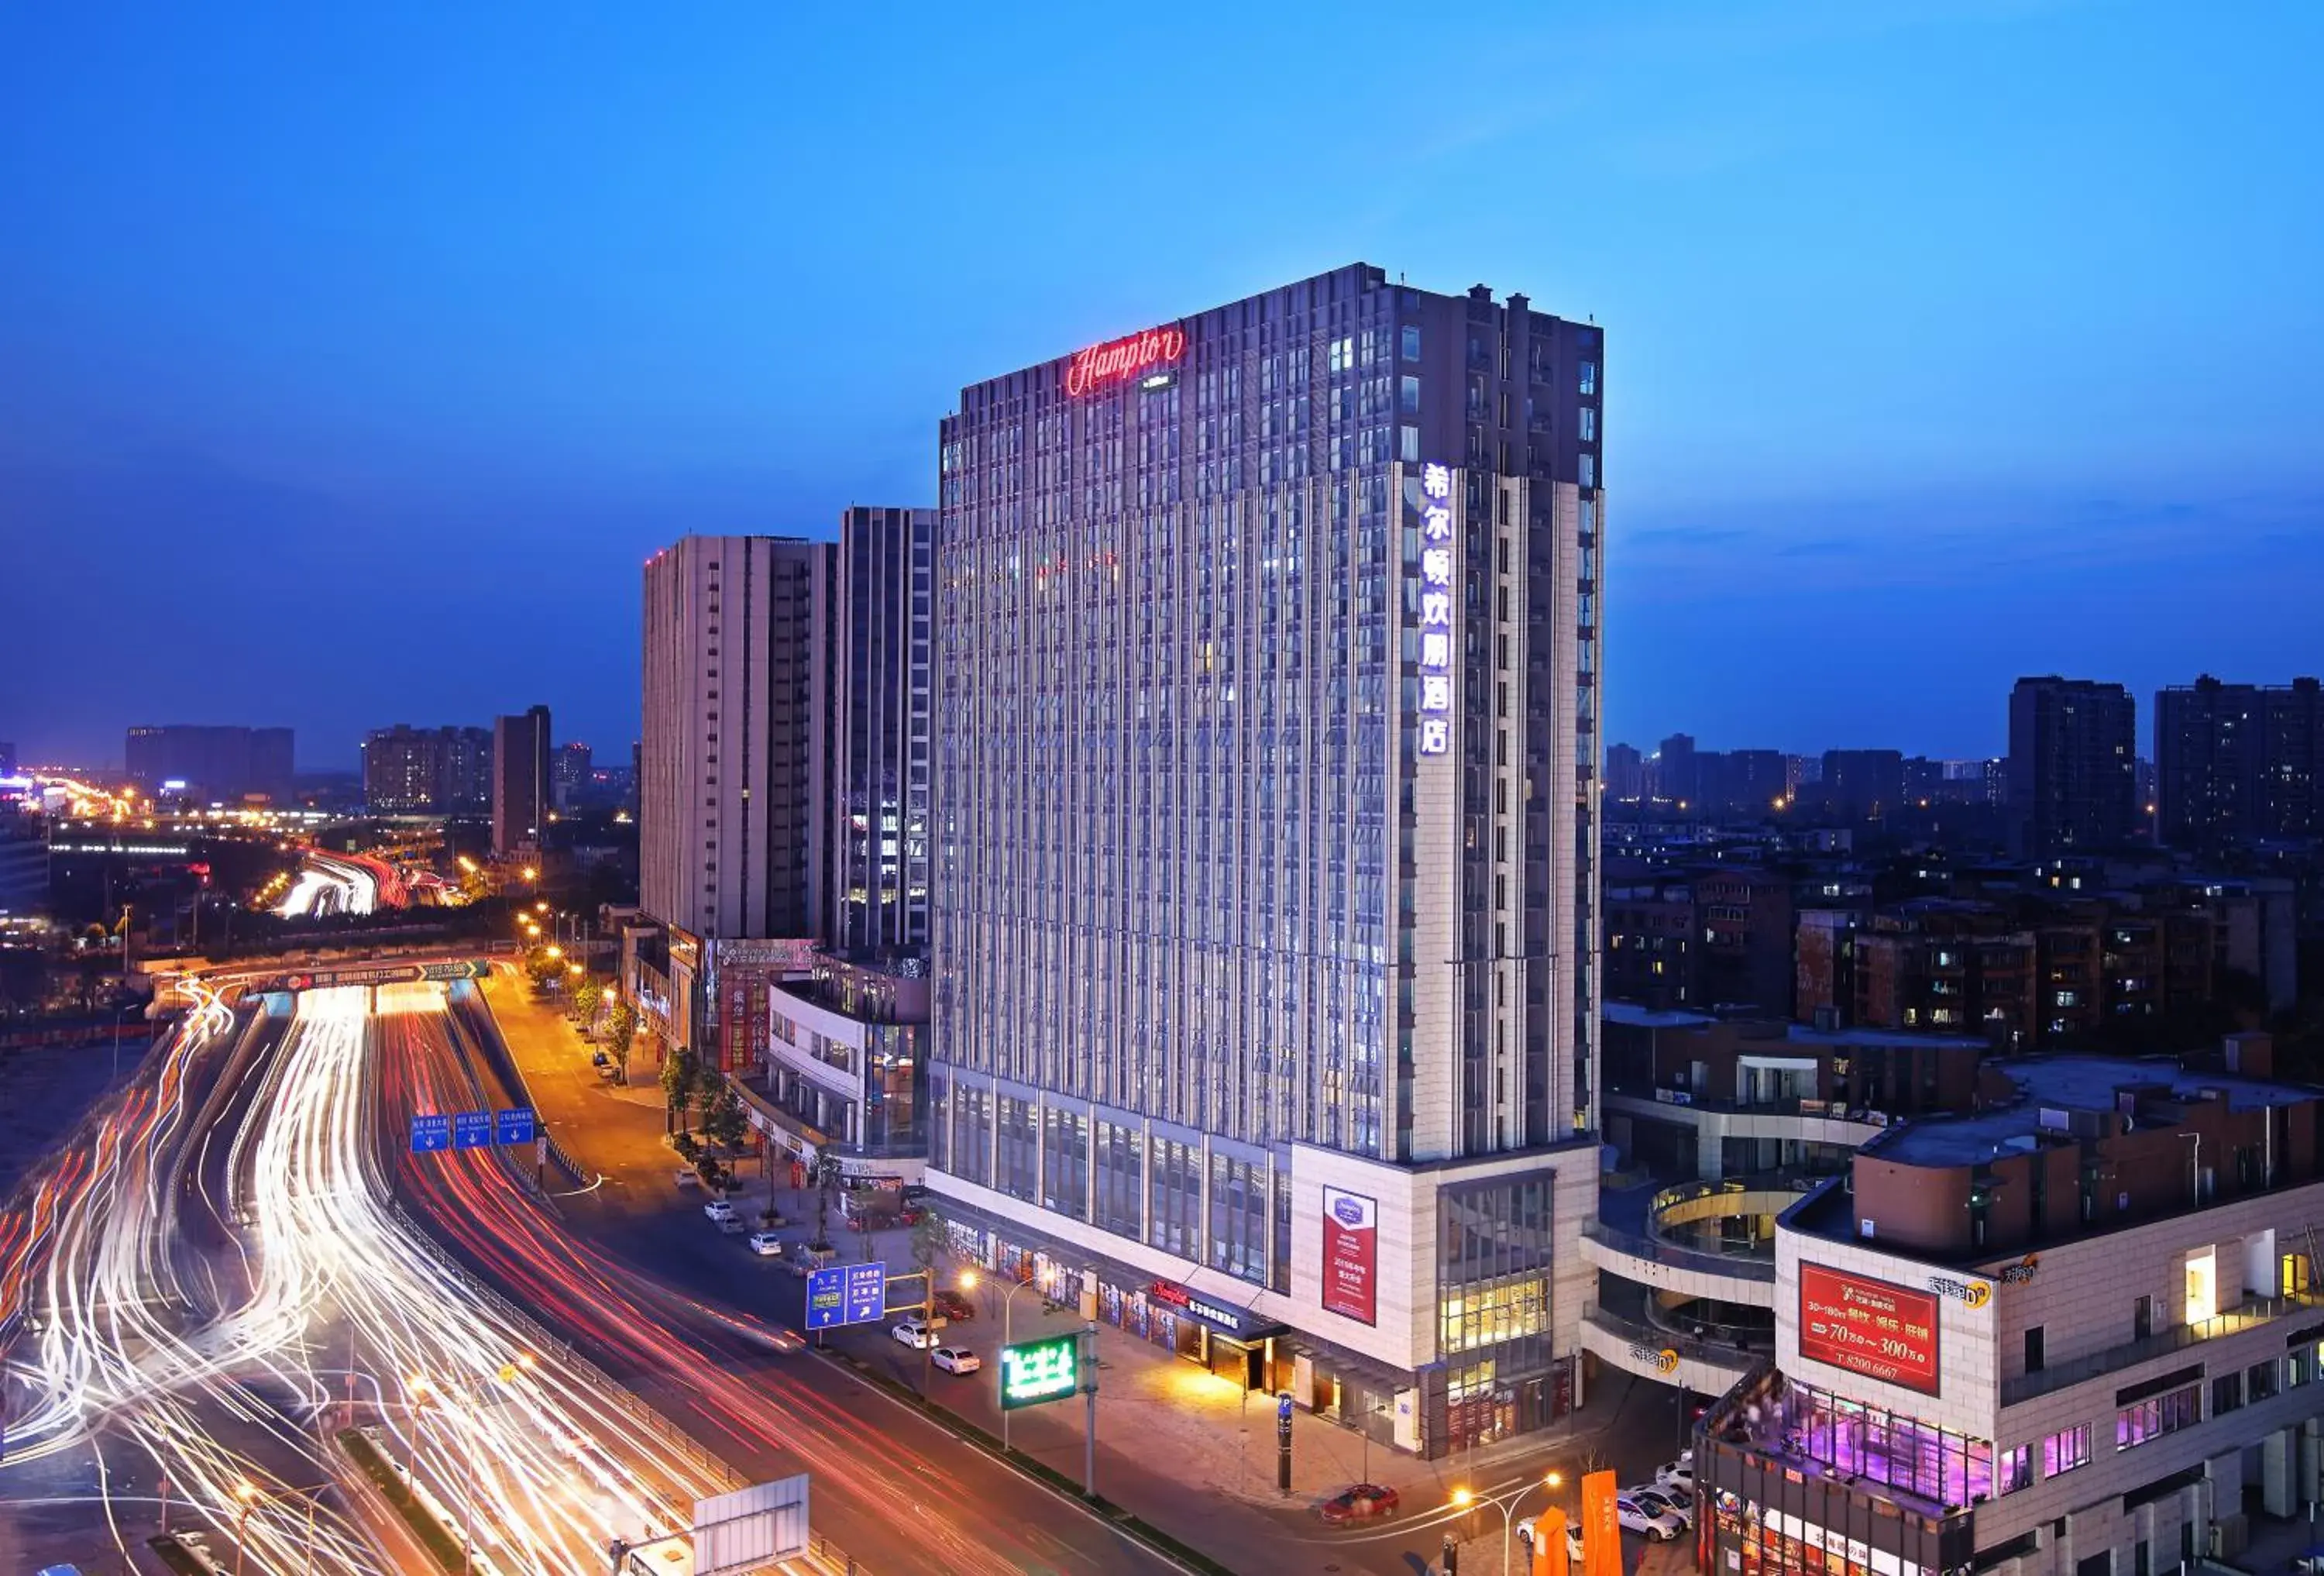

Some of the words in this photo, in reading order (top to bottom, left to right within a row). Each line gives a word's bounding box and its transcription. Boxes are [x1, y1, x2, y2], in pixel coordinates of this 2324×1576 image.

[1422, 462, 1450, 755] 希尔顿欢朋酒店
